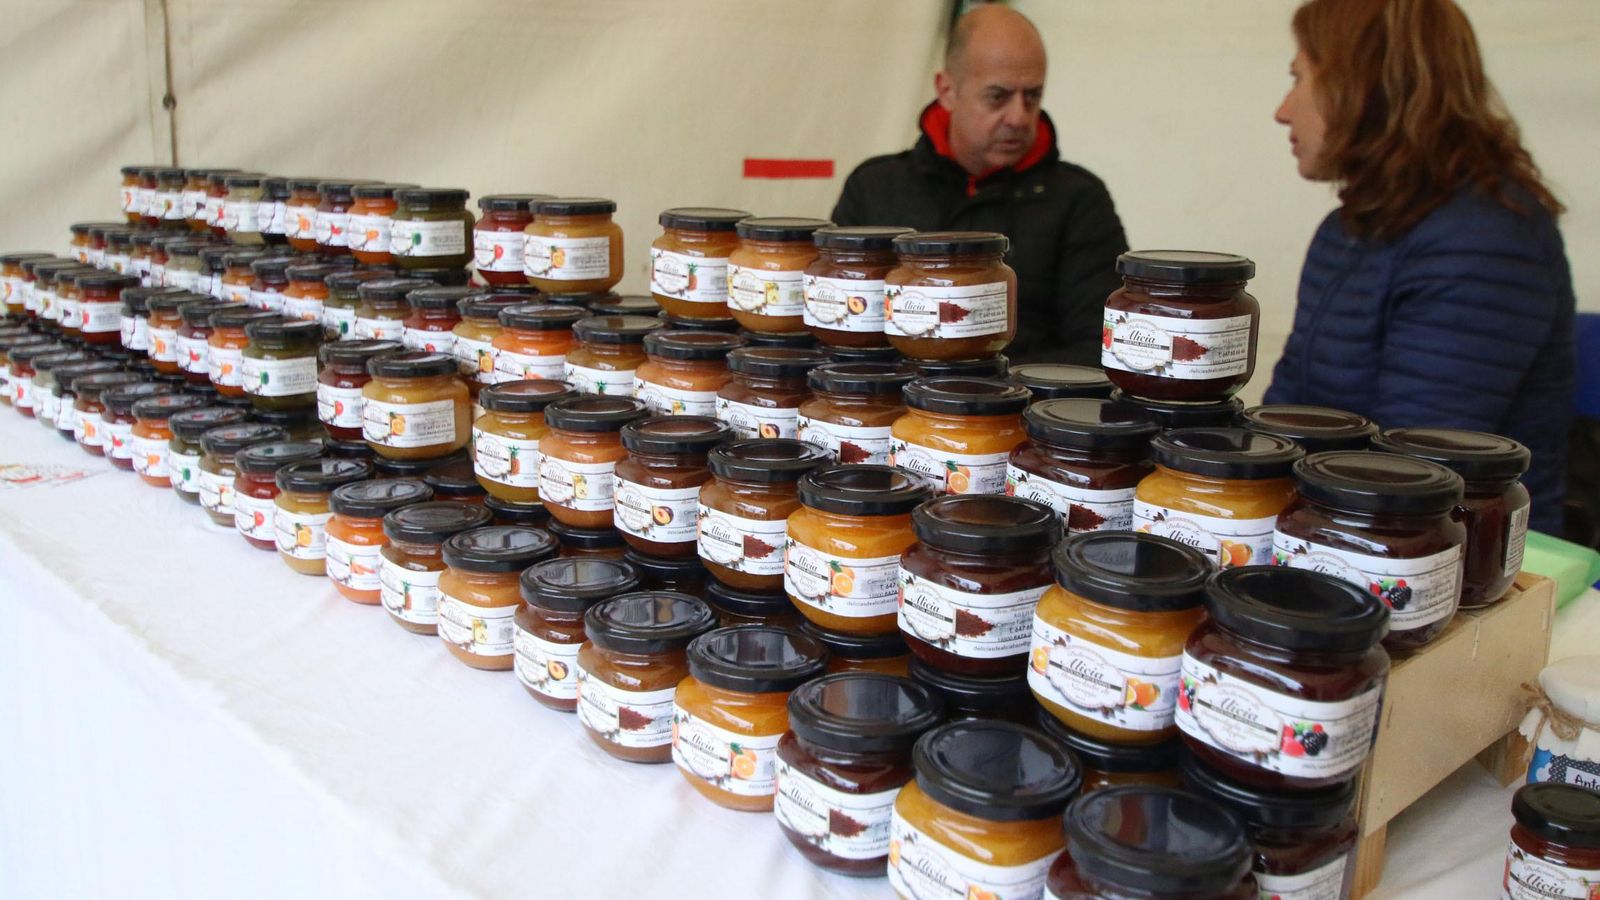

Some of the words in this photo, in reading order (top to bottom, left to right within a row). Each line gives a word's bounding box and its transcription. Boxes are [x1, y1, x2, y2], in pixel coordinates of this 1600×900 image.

[901, 299, 926, 310] Alicia
[1122, 329, 1156, 344] Alicia
[904, 458, 932, 473] Alicia
[1023, 490, 1053, 508] Alicia
[707, 525, 731, 540] Alicia
[1168, 529, 1201, 546] Alicia
[797, 555, 818, 572] Alicia
[911, 594, 940, 613] Alicia
[1060, 657, 1104, 680] Alicia
[1210, 697, 1259, 721] Alicia
[1519, 873, 1565, 895] Alicia
